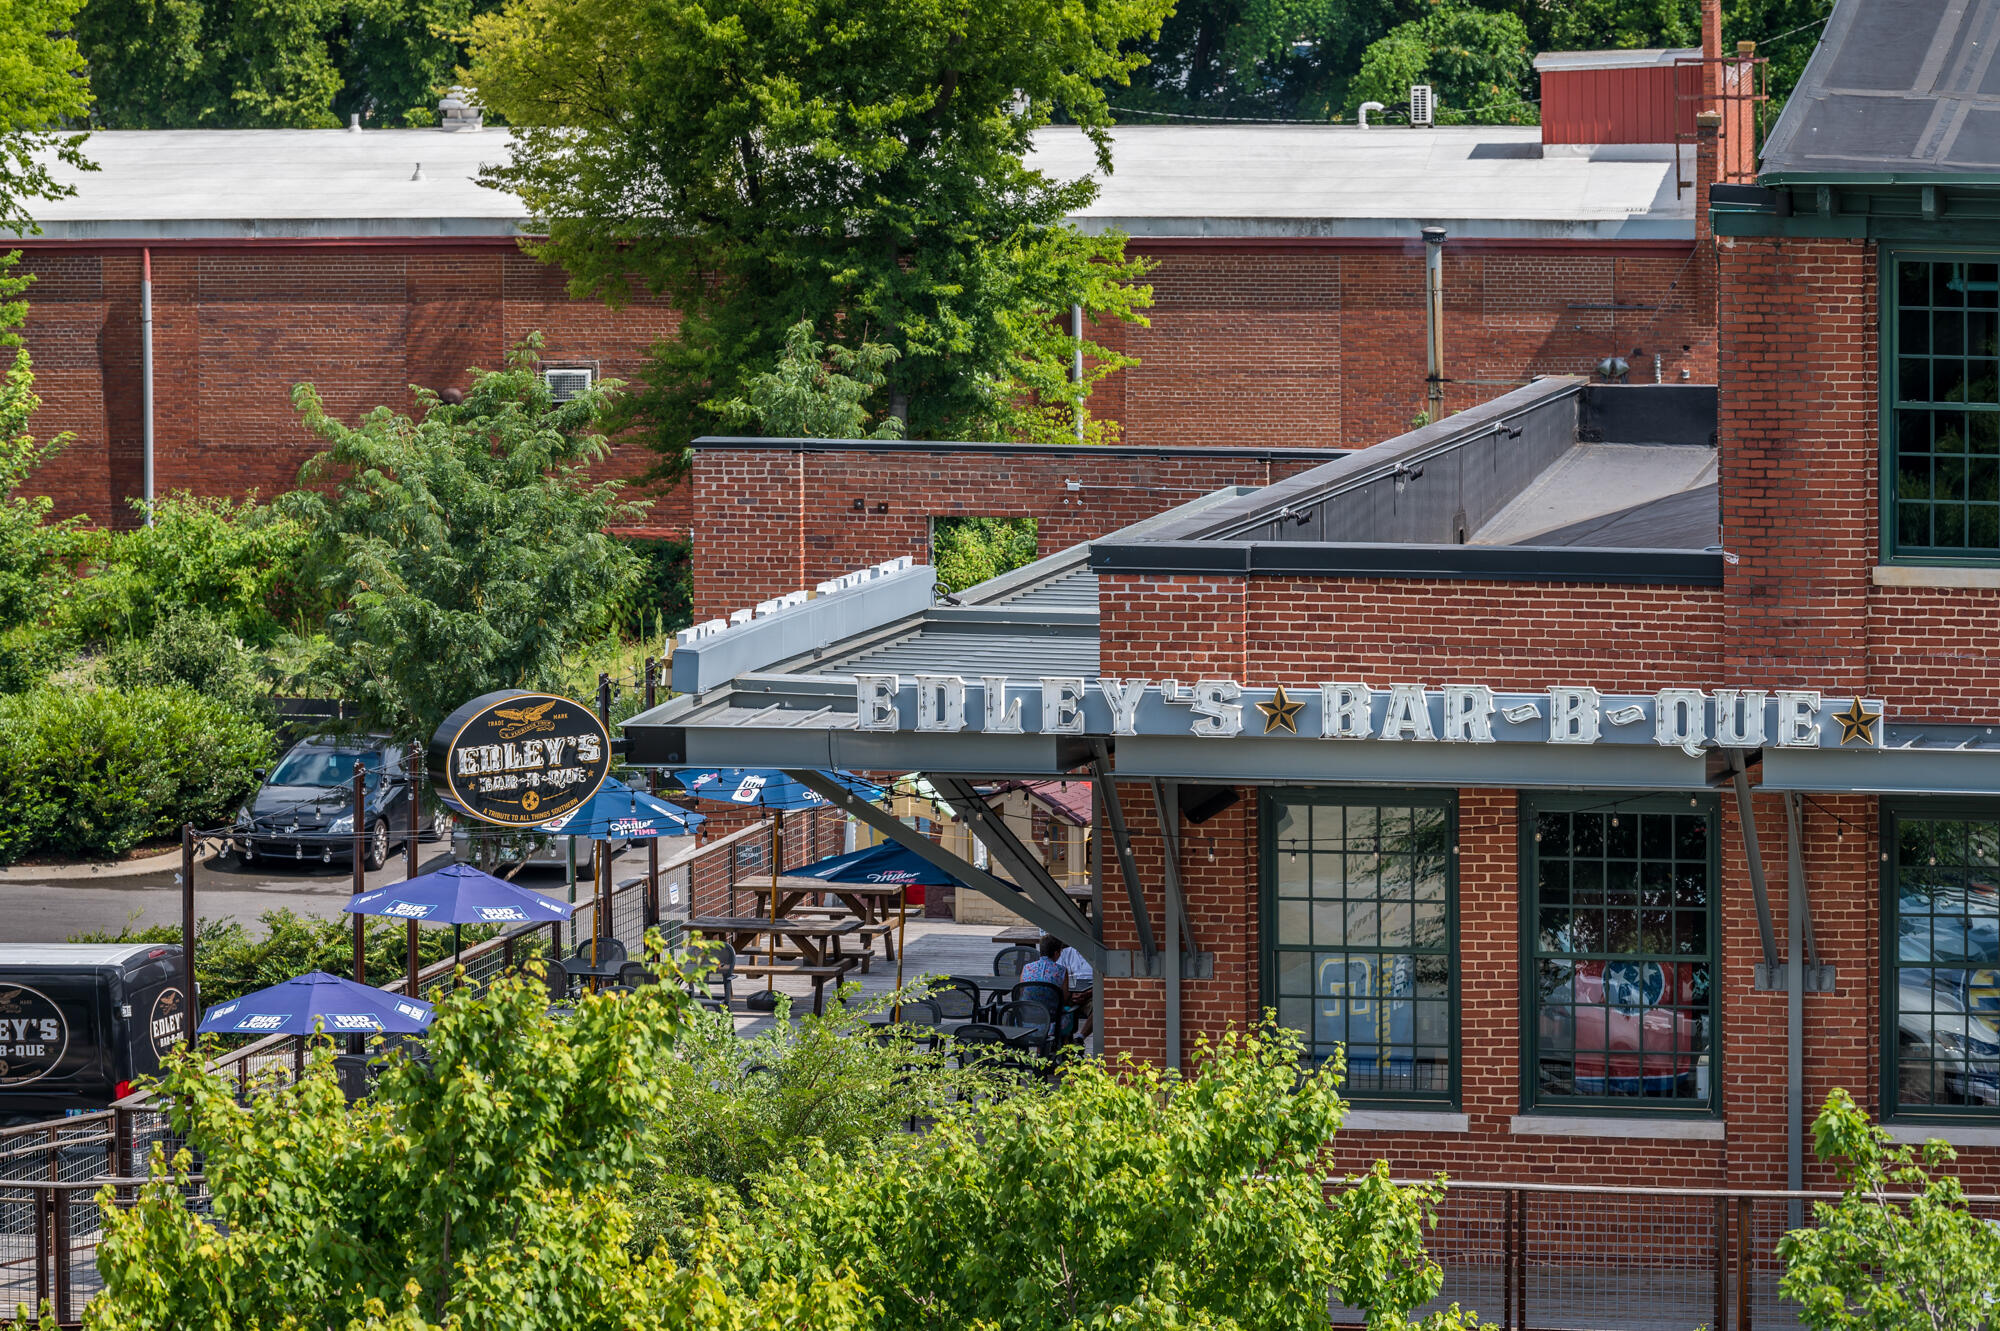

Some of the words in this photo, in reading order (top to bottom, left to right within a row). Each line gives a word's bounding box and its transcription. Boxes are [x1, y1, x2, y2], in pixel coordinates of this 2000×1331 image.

[854, 674, 1243, 738] EDLEY'S
[1319, 682, 1821, 757] BAR-B-QUE
[457, 733, 601, 777] EDLEY'S
[479, 767, 587, 793] BAR-B-QUE
[488, 809, 511, 819] TRIBUTE
[531, 811, 550, 820] THINGS
[551, 797, 579, 815] SOUTHERN
[384, 907, 428, 918] LIGHT
[396, 902, 428, 911] BUD
[152, 1012, 185, 1038] EDLEY'
[238, 1021, 282, 1029] LIGHT
[250, 1015, 282, 1023] BUD
[334, 1021, 379, 1029] LIGHT
[0, 1018, 58, 1041] EY'S
[0, 1044, 45, 1058] B-QUE
